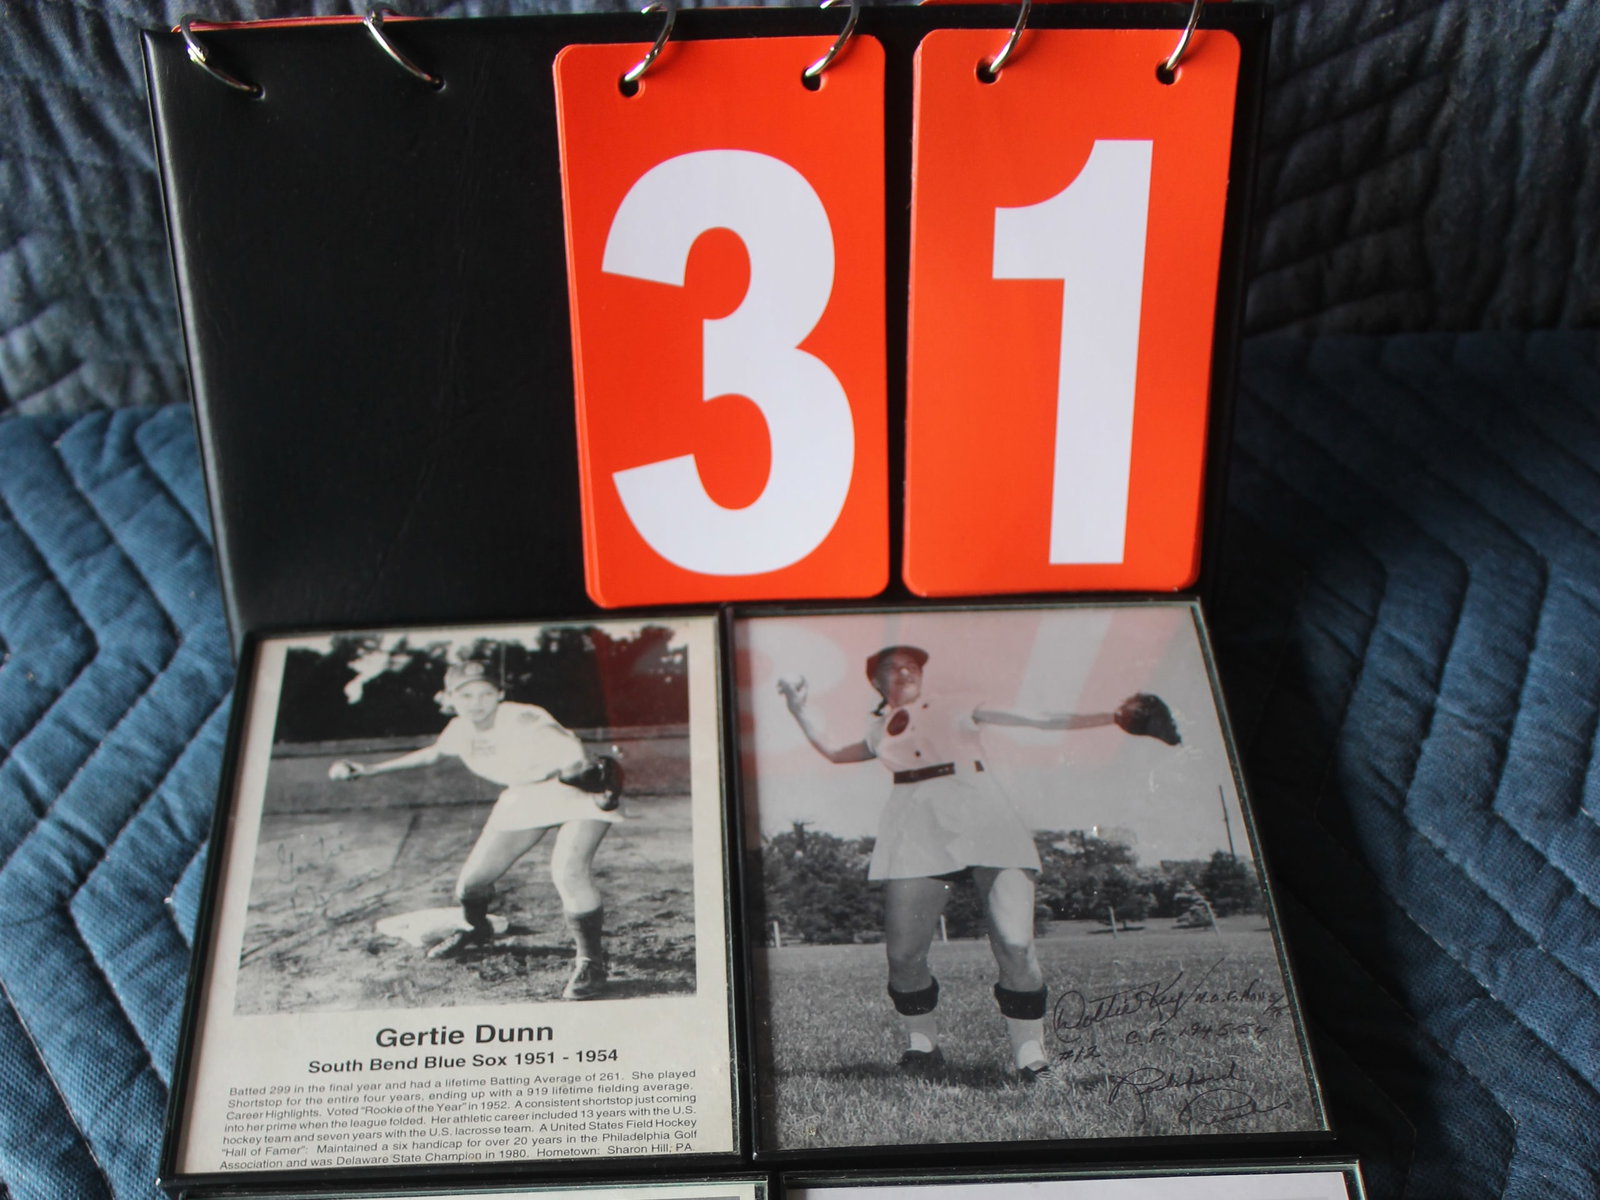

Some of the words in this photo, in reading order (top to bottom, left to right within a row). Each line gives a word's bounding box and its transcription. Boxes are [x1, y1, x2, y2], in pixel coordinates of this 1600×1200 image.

[375, 1028, 464, 1047] Gertie
[475, 1025, 553, 1044] Dunn
[307, 1059, 362, 1074] South
[369, 1057, 418, 1071] Bend
[424, 1055, 466, 1069] Blue
[471, 1053, 507, 1067] Sox
[514, 1052, 554, 1066] 1951
[575, 1049, 618, 1063] 1954
[229, 1086, 266, 1096] Batted
[269, 1085, 290, 1094] 299
[293, 1084, 304, 1093] in
[308, 1083, 325, 1093] the
[329, 1082, 353, 1092] final
[356, 1083, 381, 1093] year
[384, 1080, 406, 1090] and
[409, 1079, 431, 1089] had
[434, 1080, 441, 1088] a
[445, 1077, 486, 1087] lifetime
[490, 1076, 530, 1088] Batting
[533, 1074, 581, 1086] Average
[584, 1073, 595, 1082] of
[631, 1071, 654, 1080] She
[657, 1069, 695, 1081] played
[226, 1110, 262, 1120] Career
[265, 1108, 321, 1121] Highlights.
[326, 1106, 358, 1116] Voted
[404, 1104, 415, 1113] of
[417, 1103, 434, 1113] the
[468, 1102, 477, 1111] in
[481, 1100, 509, 1110] 1952.
[514, 1100, 522, 1109] A
[524, 1098, 580, 1108] consistent
[582, 1096, 633, 1109] shortstop
[635, 1095, 654, 1107] just
[656, 1093, 696, 1106] coming
[227, 1097, 282, 1110] Shortstop
[286, 1096, 301, 1106] for
[305, 1096, 322, 1105] the
[326, 1094, 359, 1104] entire
[363, 1093, 385, 1103] four
[389, 1093, 424, 1104] years,
[428, 1090, 467, 1103] ending
[470, 1091, 485, 1101] up
[489, 1088, 512, 1098] with
[526, 1087, 548, 1096] 919
[552, 1085, 593, 1095] lifetime
[597, 1083, 639, 1096] fielding
[222, 1134, 261, 1147] hockey
[264, 1133, 291, 1143] team
[293, 1132, 314, 1142] and
[317, 1133, 349, 1141] seven
[352, 1132, 382, 1142] years
[384, 1129, 406, 1138] with
[409, 1128, 426, 1137] the
[429, 1127, 451, 1137] U.S.
[455, 1125, 500, 1136] lacrosse
[503, 1124, 533, 1134] team.
[539, 1123, 547, 1132] A
[550, 1122, 585, 1132] United
[588, 1120, 623, 1130] States
[626, 1119, 652, 1129] Field
[655, 1118, 696, 1130] Hockey
[224, 1123, 243, 1132] into
[246, 1122, 263, 1131] her
[266, 1121, 296, 1133] prime
[299, 1120, 328, 1129] when
[331, 1119, 347, 1128] the
[350, 1117, 386, 1130] league
[389, 1116, 426, 1126] folded.
[431, 1115, 450, 1124] Her
[453, 1113, 491, 1123] athletic
[494, 1113, 528, 1122] career
[531, 1110, 577, 1120] included
[580, 1109, 593, 1118] 13
[596, 1110, 626, 1120] years
[628, 1107, 650, 1116] with
[653, 1106, 669, 1115] the
[672, 1105, 696, 1115] U.S.
[219, 1158, 282, 1170] Association
[285, 1157, 307, 1167] and
[310, 1158, 332, 1166] was
[336, 1154, 388, 1165] Delaware
[392, 1153, 421, 1163] State
[424, 1150, 481, 1164] Champion
[485, 1150, 495, 1159] in
[499, 1149, 529, 1159] 1980.
[536, 1146, 599, 1157] Hometown:
[607, 1144, 647, 1155] Sharon
[675, 1142, 695, 1152] PA.
[250, 1147, 261, 1156] of
[316, 1142, 377, 1153] Maintained
[392, 1141, 407, 1150] six
[411, 1139, 462, 1152] handicap
[466, 1138, 481, 1147] for
[484, 1139, 510, 1147] over
[513, 1136, 527, 1146] 20
[531, 1137, 562, 1147] years
[566, 1135, 576, 1144] in
[580, 1134, 597, 1143] the
[602, 1131, 670, 1145] Philadelphia
[673, 1130, 696, 1139] Golf
